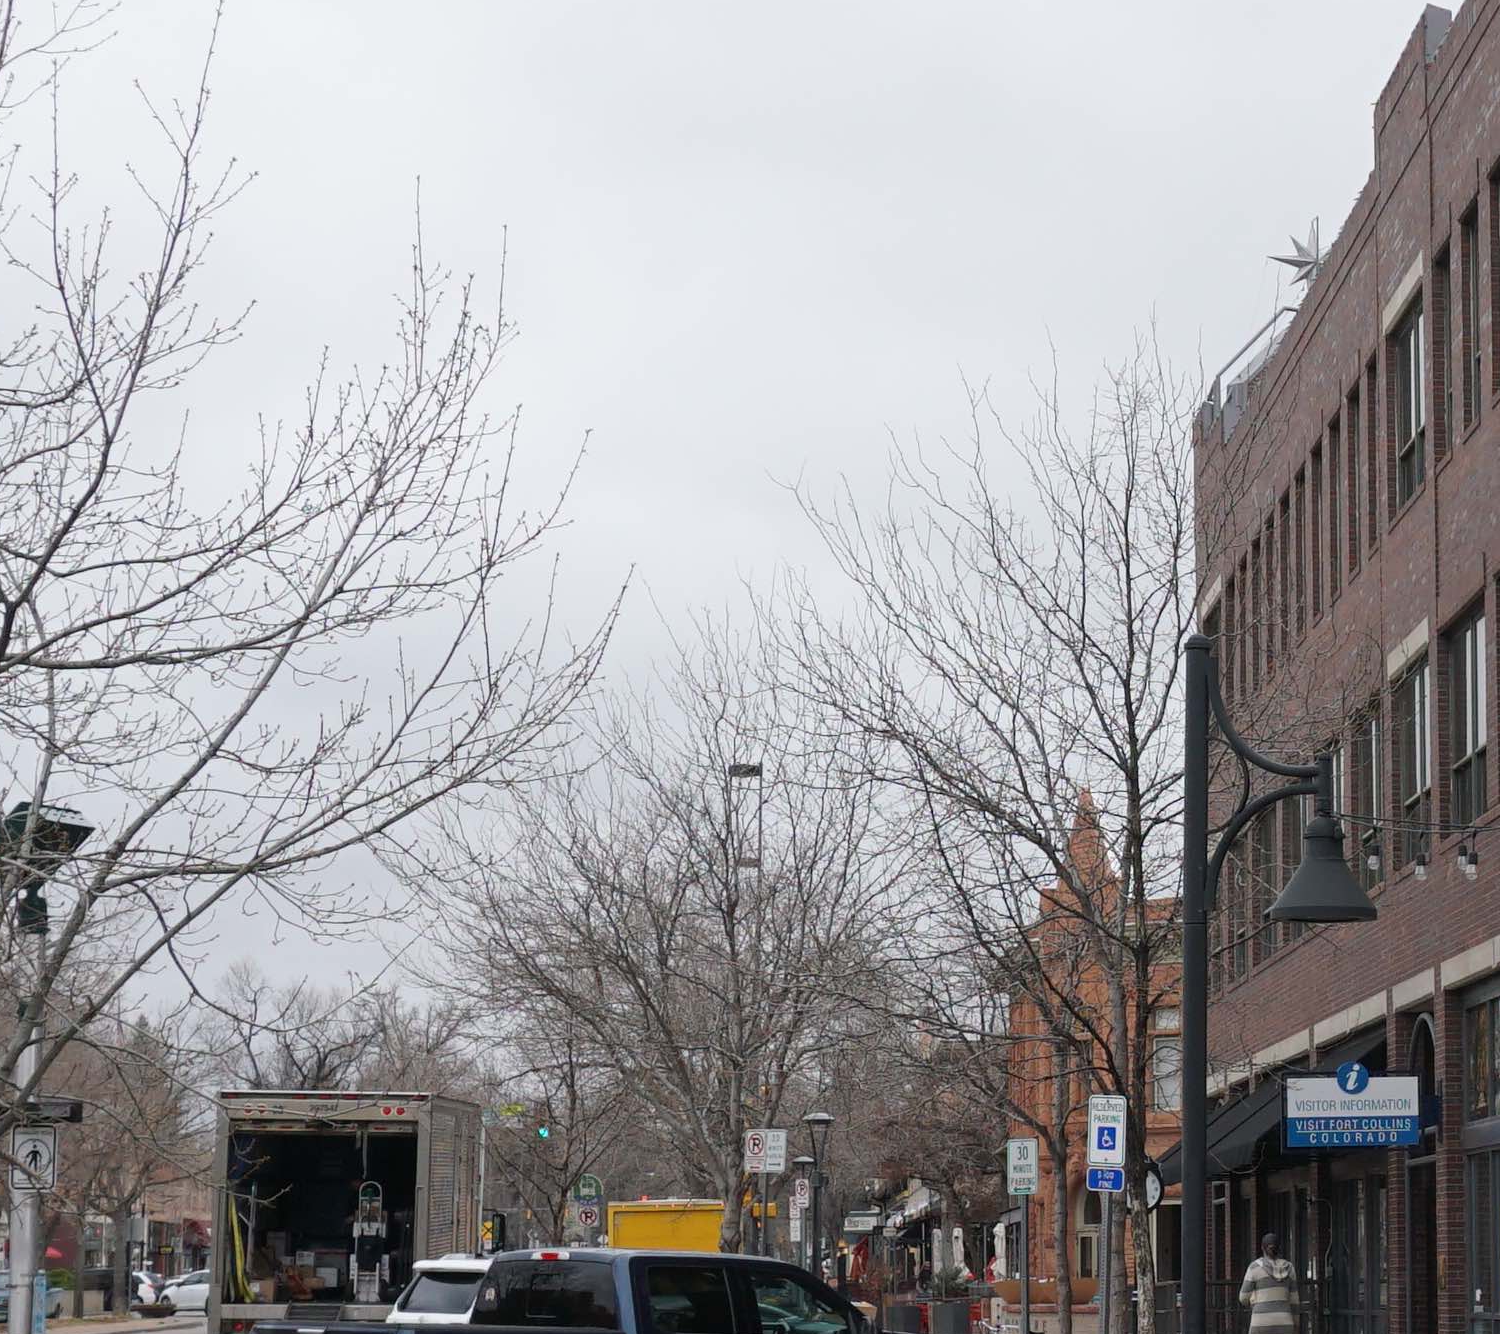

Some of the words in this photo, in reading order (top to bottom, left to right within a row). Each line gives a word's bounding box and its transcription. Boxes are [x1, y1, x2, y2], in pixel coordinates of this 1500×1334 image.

[1295, 1098, 1337, 1112] VISITOR
[1340, 1097, 1412, 1111] INFORMATION
[1093, 1113, 1121, 1124] PARKING
[1295, 1119, 1326, 1131] VISIT
[1329, 1119, 1358, 1130] FORT
[1362, 1118, 1412, 1130] COLLINS
[1309, 1132, 1398, 1144] COLORADO
[1017, 1145, 1029, 1161] 30
[1012, 1163, 1032, 1174] MINUTE
[1010, 1177, 1035, 1187] PARKING
